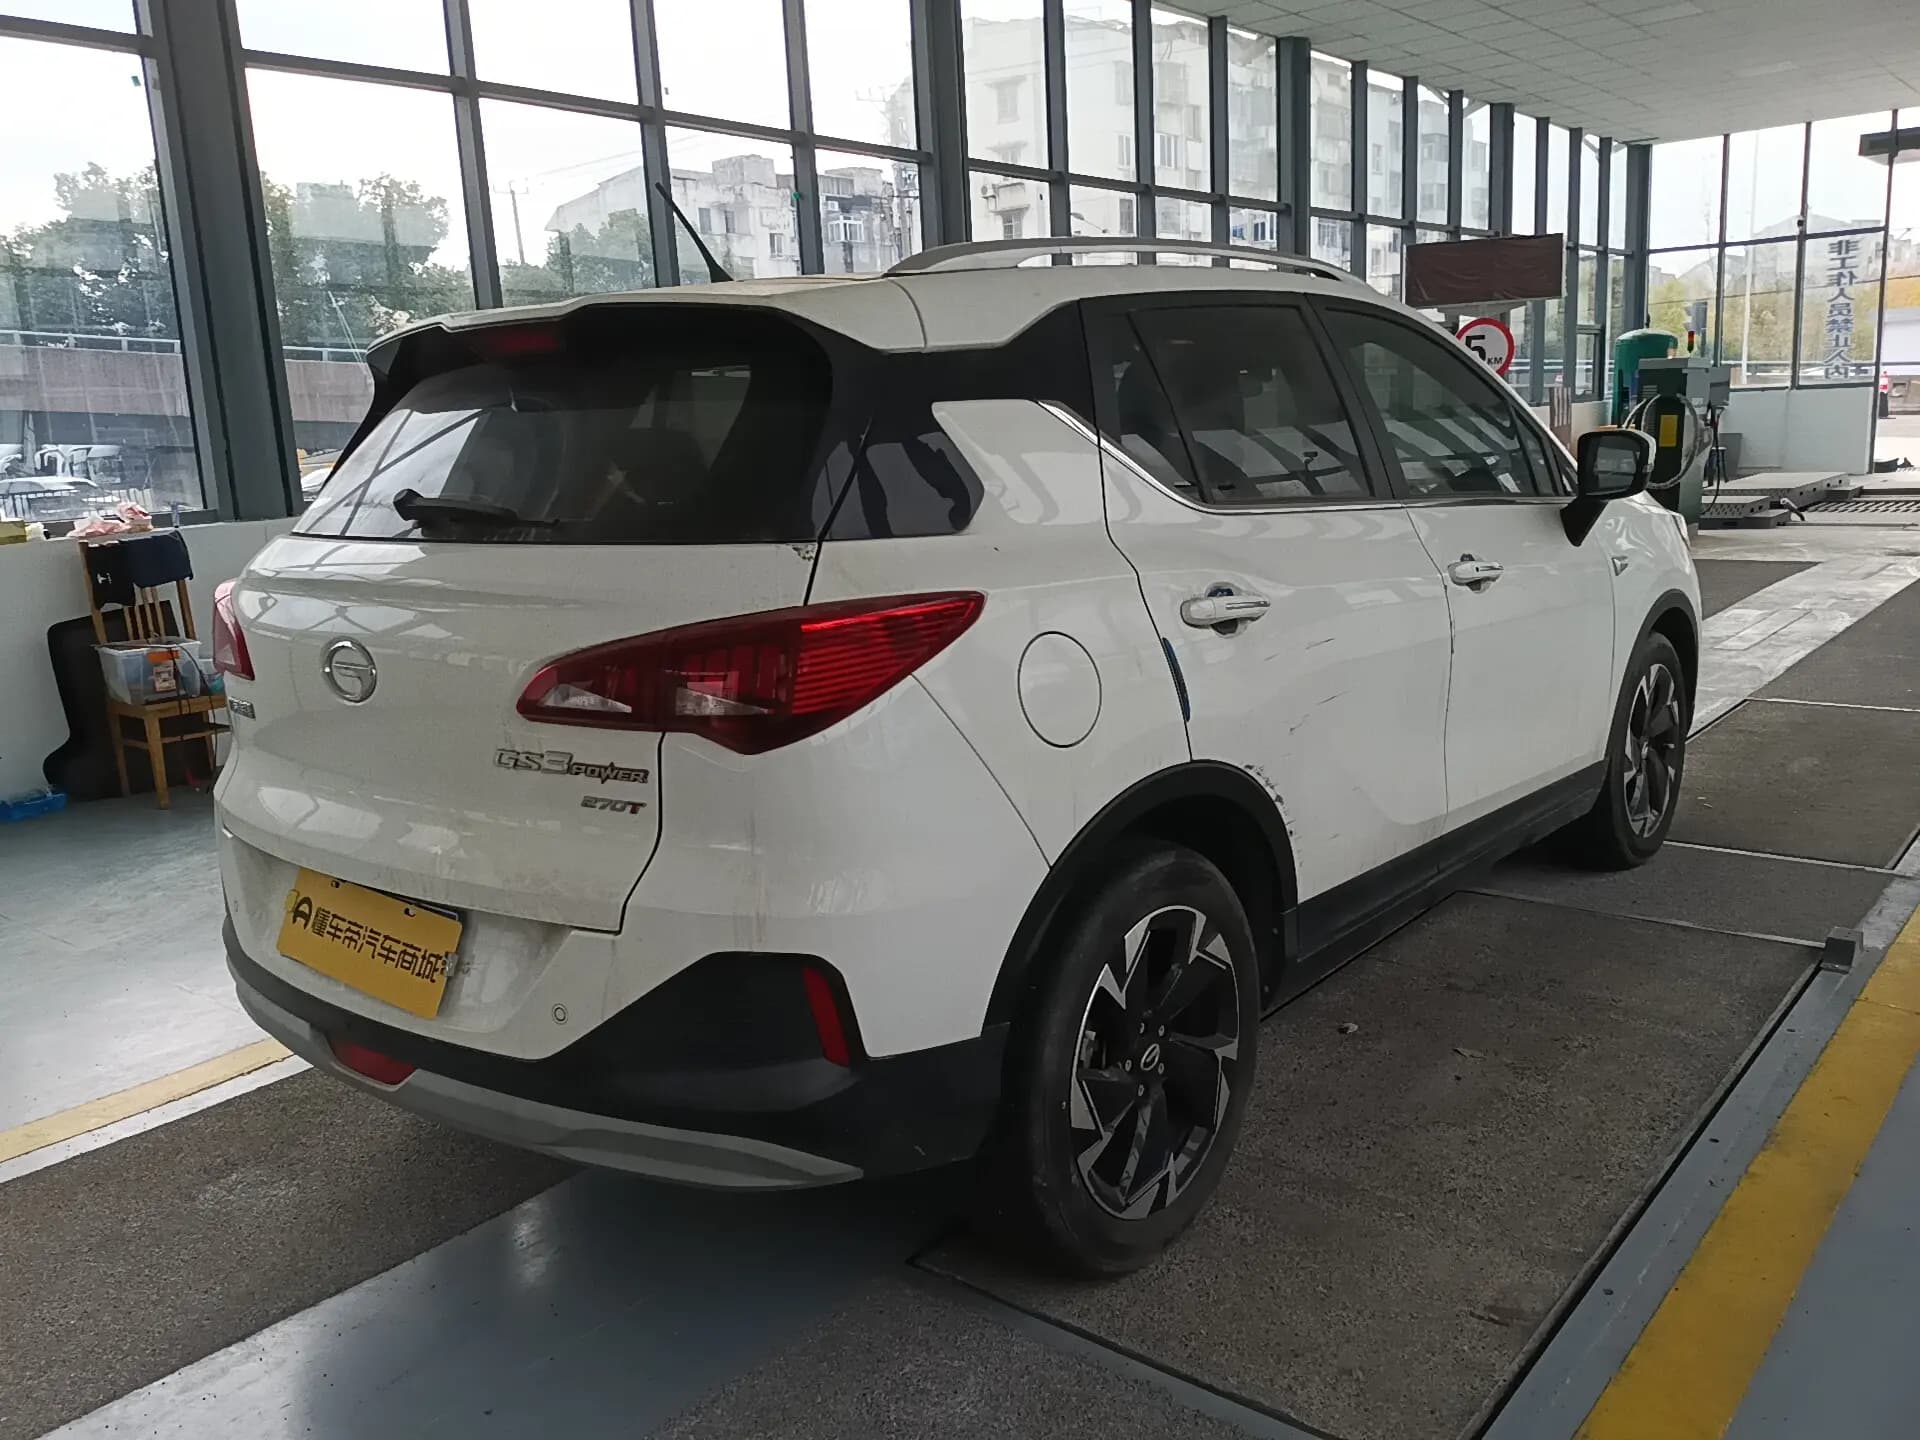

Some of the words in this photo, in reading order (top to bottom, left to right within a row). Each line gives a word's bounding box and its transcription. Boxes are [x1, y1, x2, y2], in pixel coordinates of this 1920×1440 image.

[1465, 334, 1486, 362] 5
[1487, 356, 1503, 365] KM
[580, 795, 648, 815] 270T
